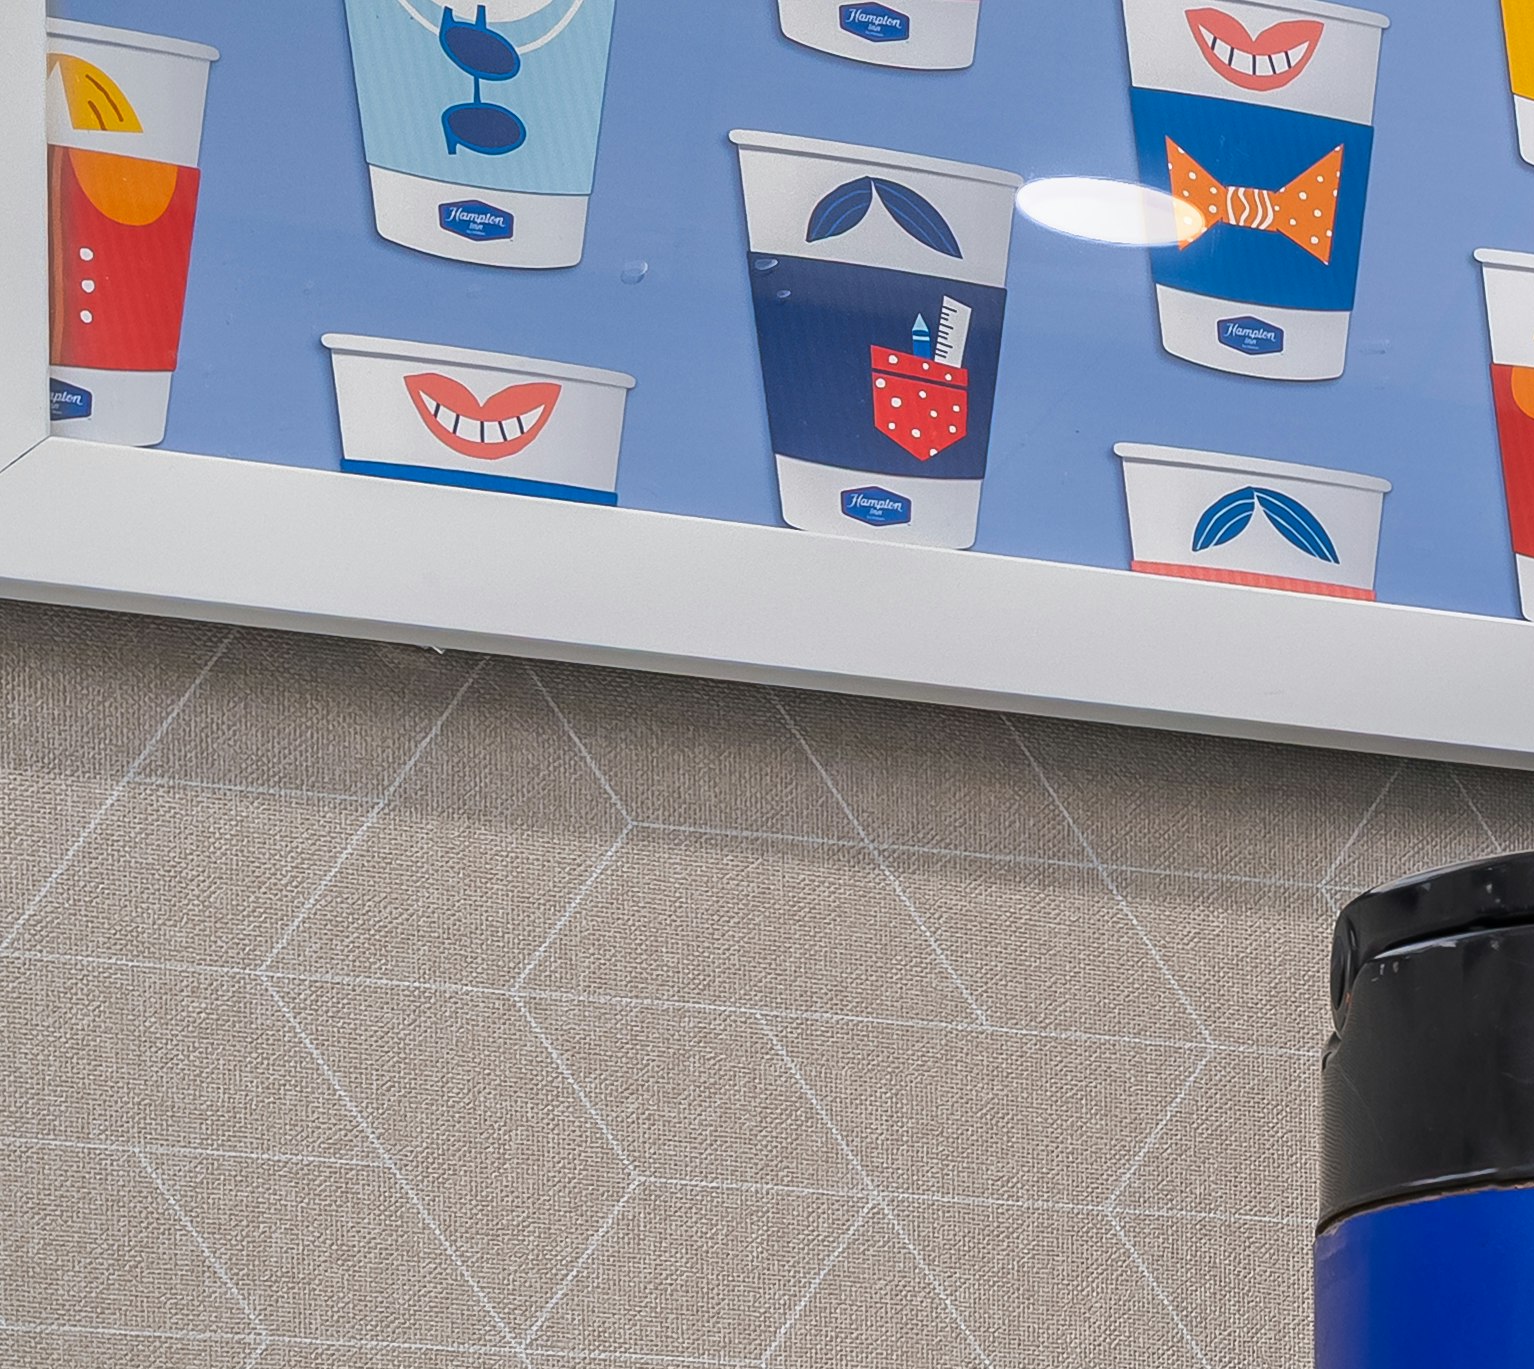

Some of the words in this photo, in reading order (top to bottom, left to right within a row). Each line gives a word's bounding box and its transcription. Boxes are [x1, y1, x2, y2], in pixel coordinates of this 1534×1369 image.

[848, 8, 902, 29] Hampton
[448, 206, 506, 227] Hampton
[1224, 323, 1276, 341] Hampton
[848, 493, 902, 513] Hampton
